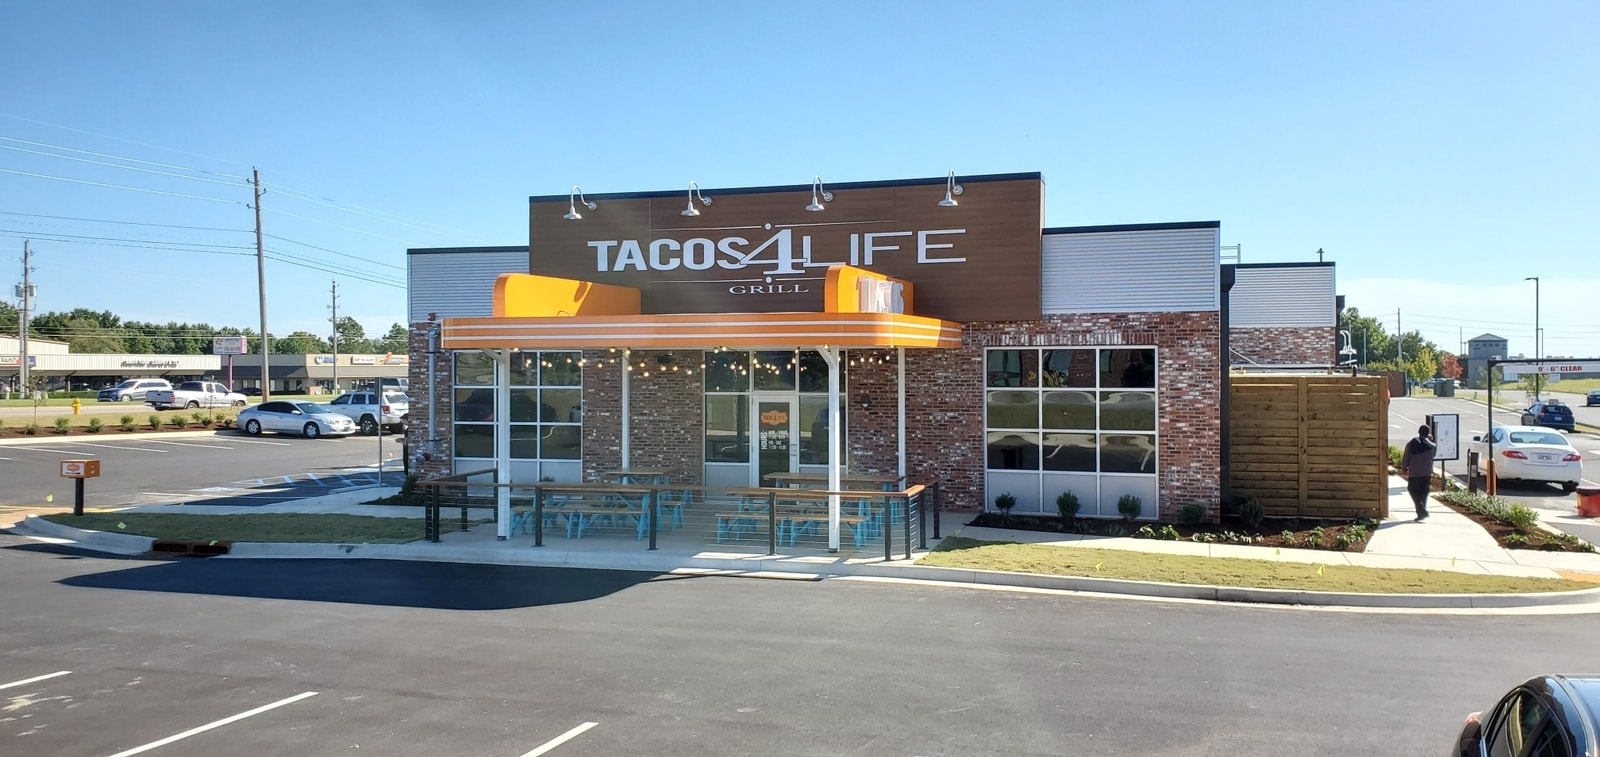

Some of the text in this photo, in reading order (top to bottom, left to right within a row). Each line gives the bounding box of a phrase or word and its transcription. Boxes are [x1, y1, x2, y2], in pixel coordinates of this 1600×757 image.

[587, 229, 967, 275] TACOS 4 LIFE
[728, 285, 810, 295] GRILL
